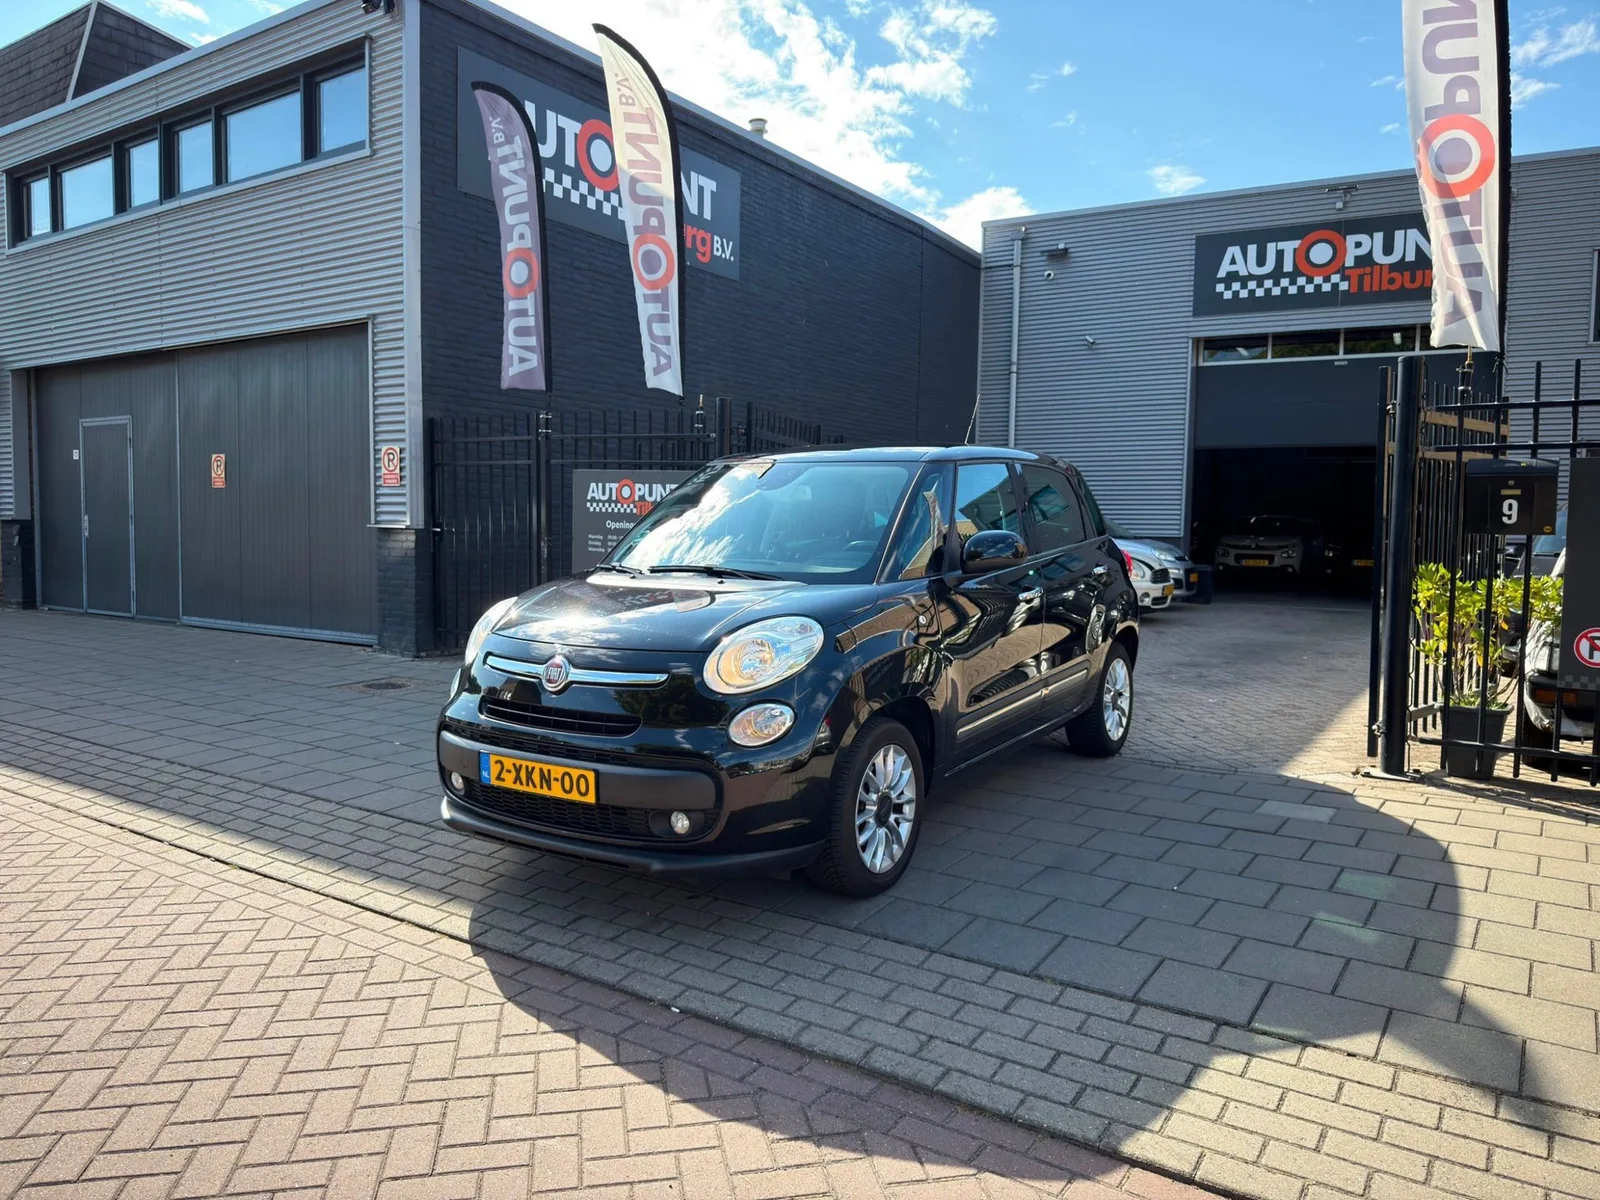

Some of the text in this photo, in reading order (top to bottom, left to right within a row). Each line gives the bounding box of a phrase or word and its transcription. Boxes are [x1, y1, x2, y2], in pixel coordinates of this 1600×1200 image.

[713, 234, 735, 262] B.V.
[1216, 228, 1433, 278] AUTOPUN
[1501, 498, 1519, 525] 9
[546, 666, 562, 681] FIAT
[494, 759, 590, 797] 2-XKN-00
